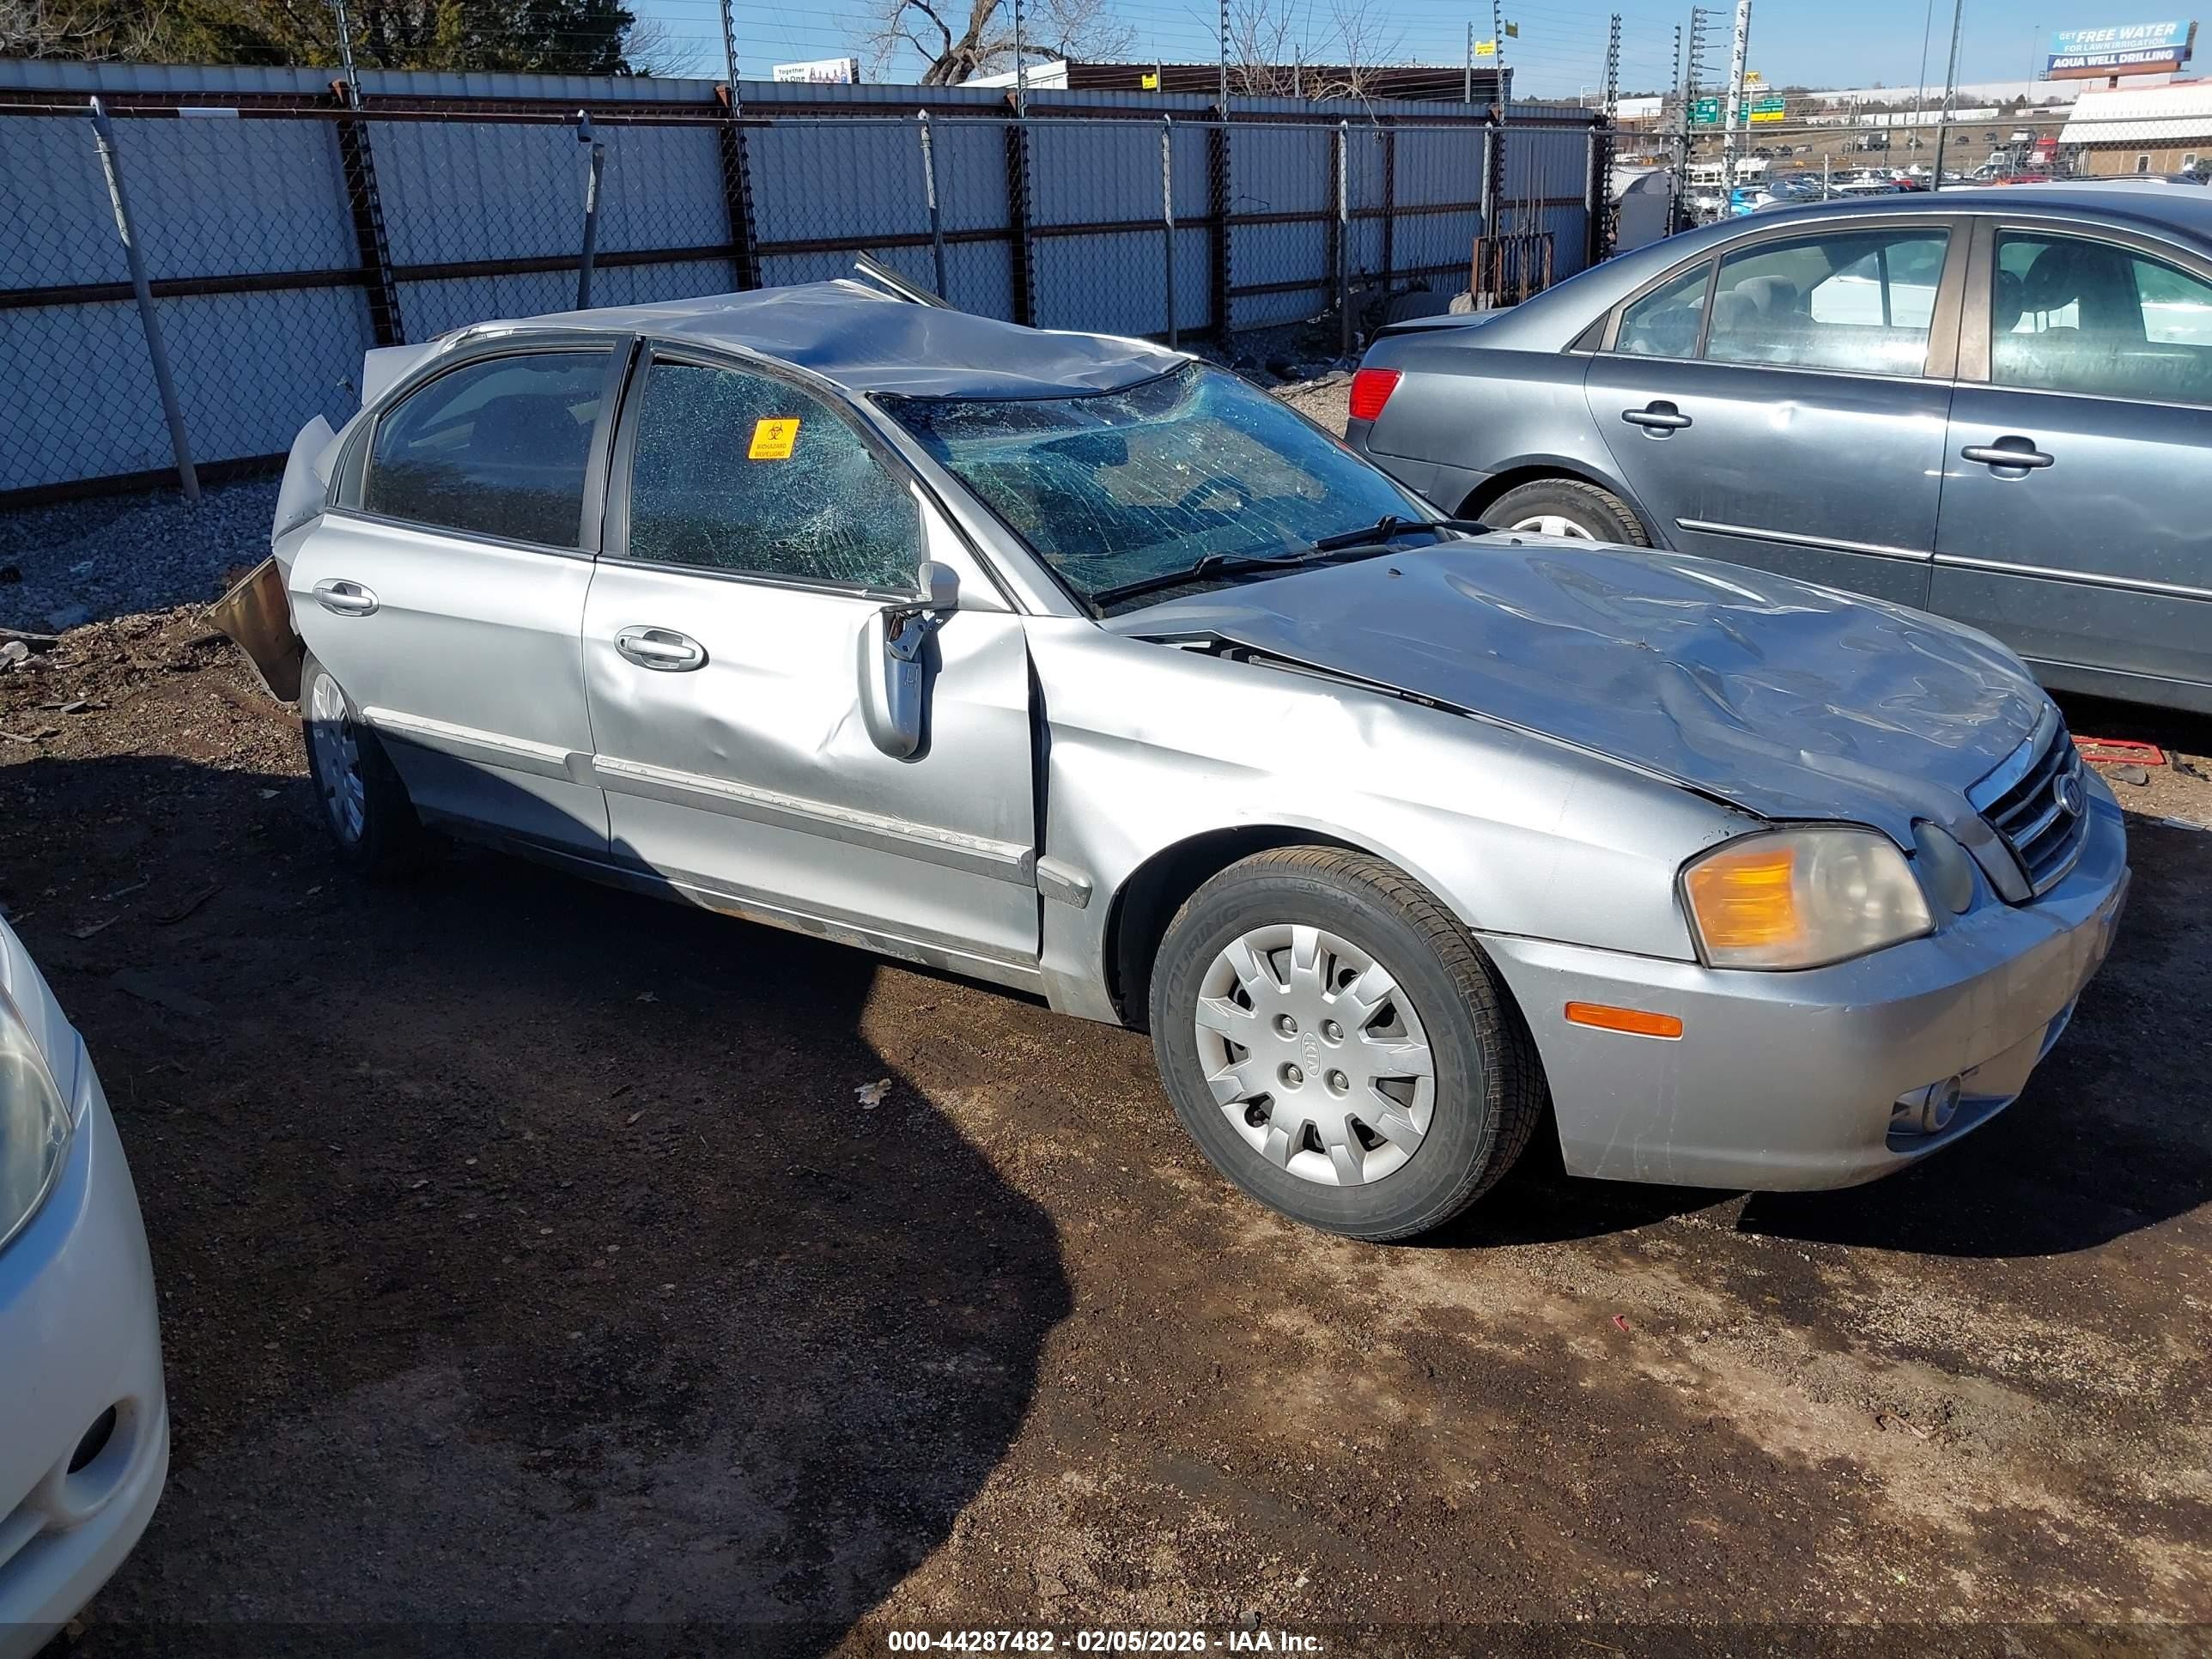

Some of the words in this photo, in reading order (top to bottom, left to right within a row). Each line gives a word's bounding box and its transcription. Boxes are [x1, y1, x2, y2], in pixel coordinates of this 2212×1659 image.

[2076, 28, 2117, 43] FREE
[2119, 23, 2177, 40] WATER
[2084, 41, 2111, 51] LAWN
[2112, 38, 2166, 49] IRRIGATION
[2053, 57, 2085, 68] AQUA
[2087, 54, 2117, 66] WELL
[2118, 50, 2174, 64] DRILLING
[1165, 900, 1242, 1019] TOURING
[1304, 1039, 1319, 1073] KIA
